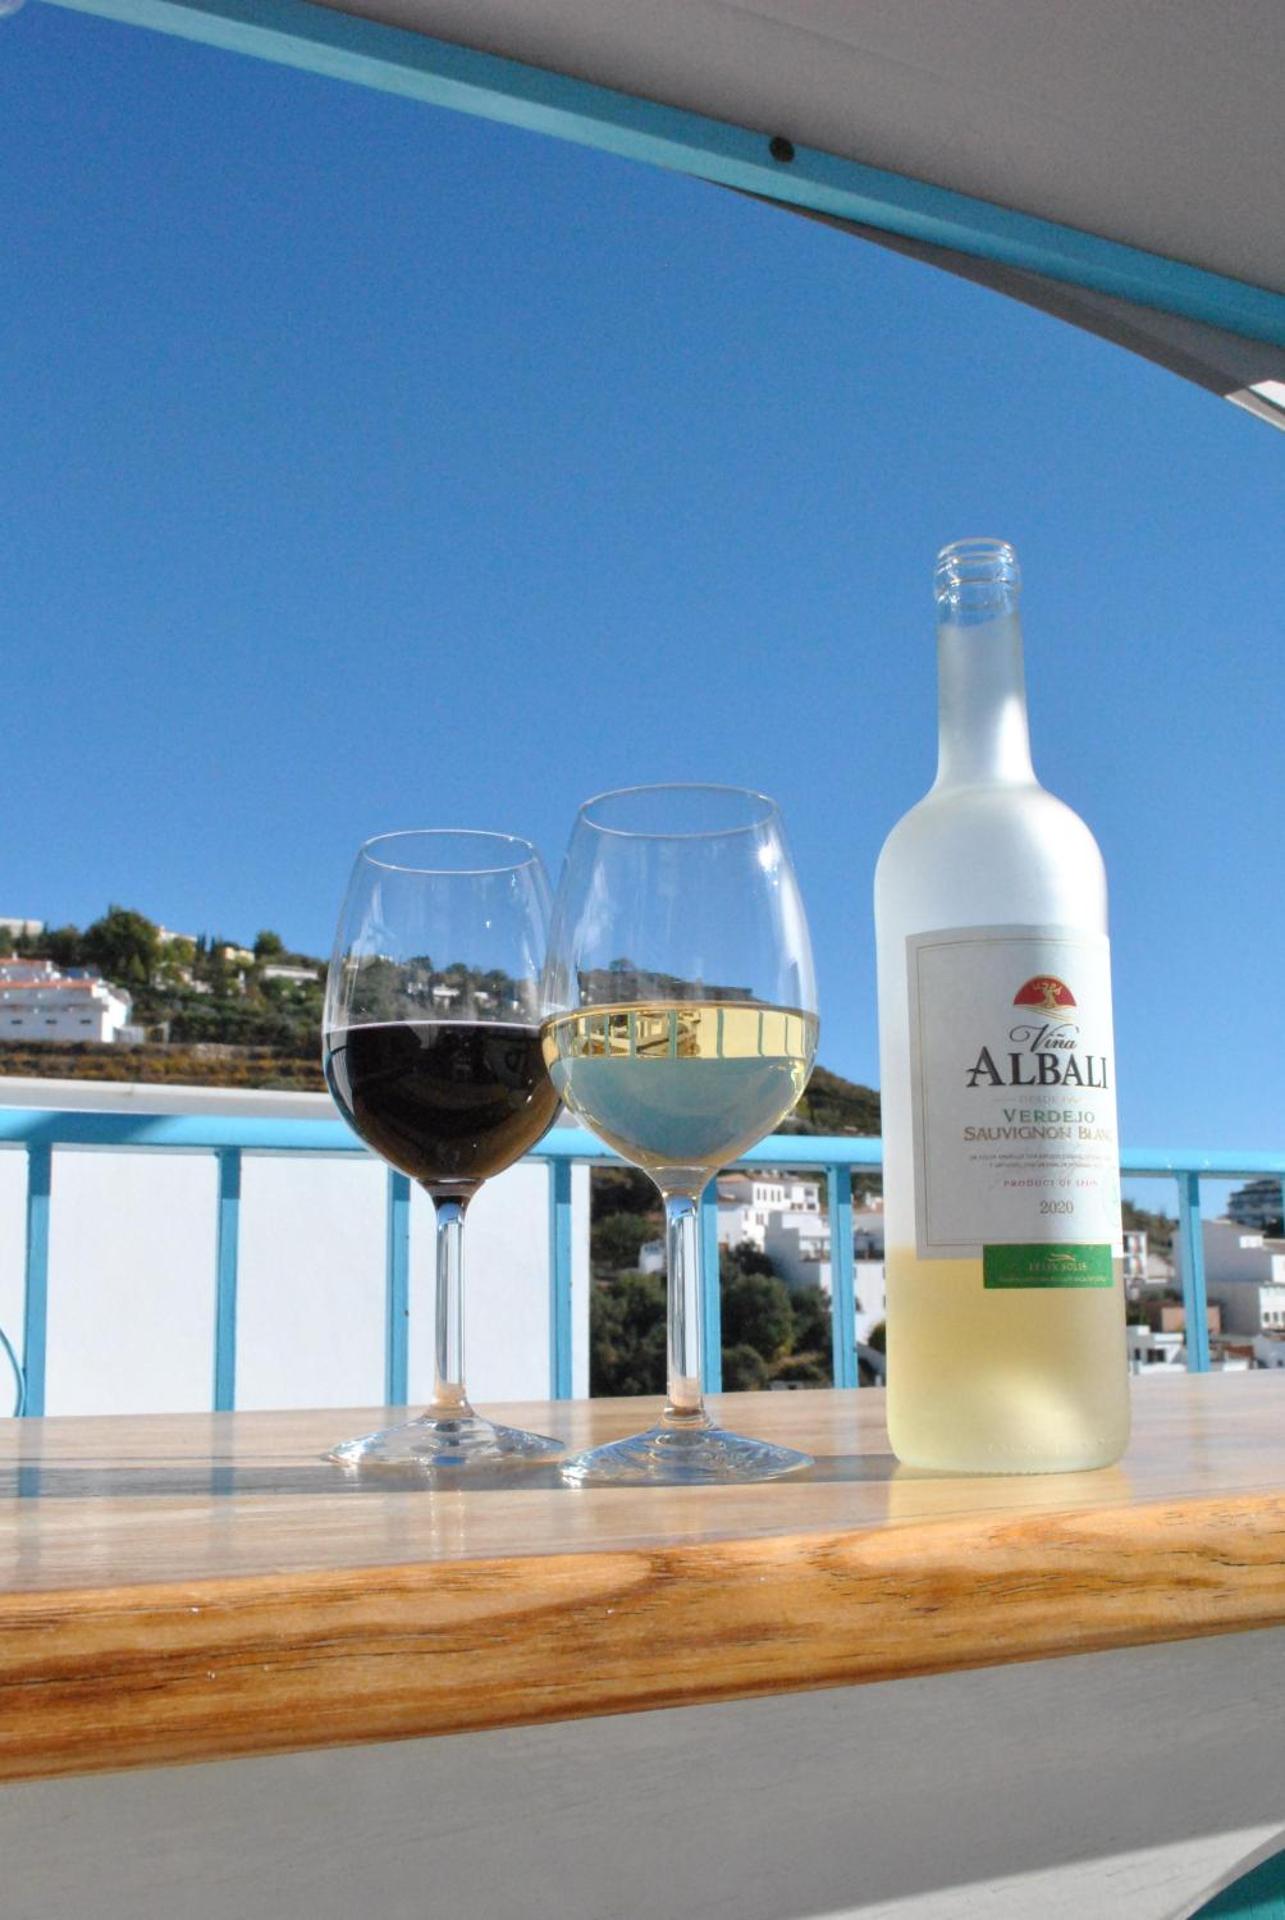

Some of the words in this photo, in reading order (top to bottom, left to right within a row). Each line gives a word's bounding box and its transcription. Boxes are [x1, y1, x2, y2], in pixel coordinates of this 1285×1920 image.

[1009, 1024, 1080, 1052] Viña
[965, 1046, 1109, 1089] ALBALI
[1003, 1108, 1095, 1124] VERDEJO
[963, 1126, 1072, 1142] SAUVIGNON
[1003, 1178, 1055, 1188] PRODUCT
[1059, 1178, 1072, 1188] OF
[1039, 1199, 1074, 1215] 2020
